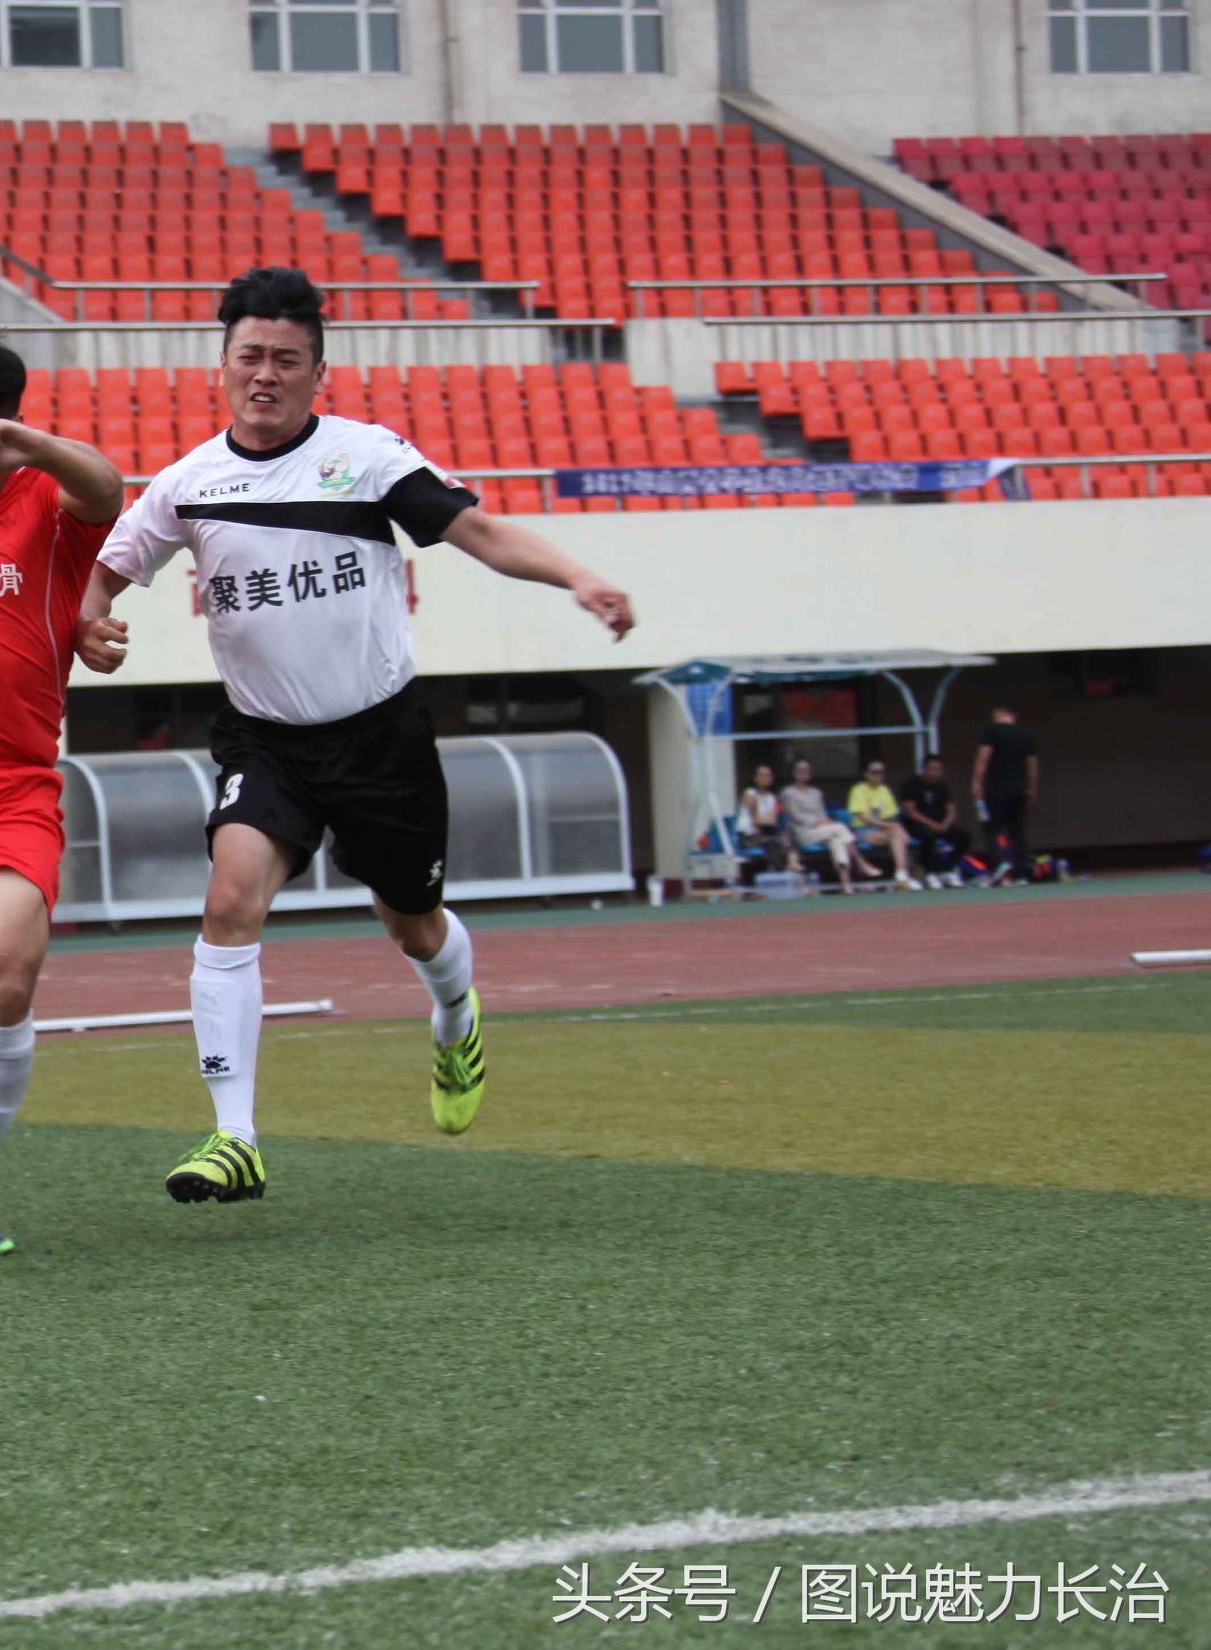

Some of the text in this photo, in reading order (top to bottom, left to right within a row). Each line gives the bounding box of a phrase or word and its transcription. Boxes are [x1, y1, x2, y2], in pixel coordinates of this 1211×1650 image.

[199, 483, 250, 498] KELME
[209, 551, 366, 614] 聚美优品
[220, 773, 243, 810] 3
